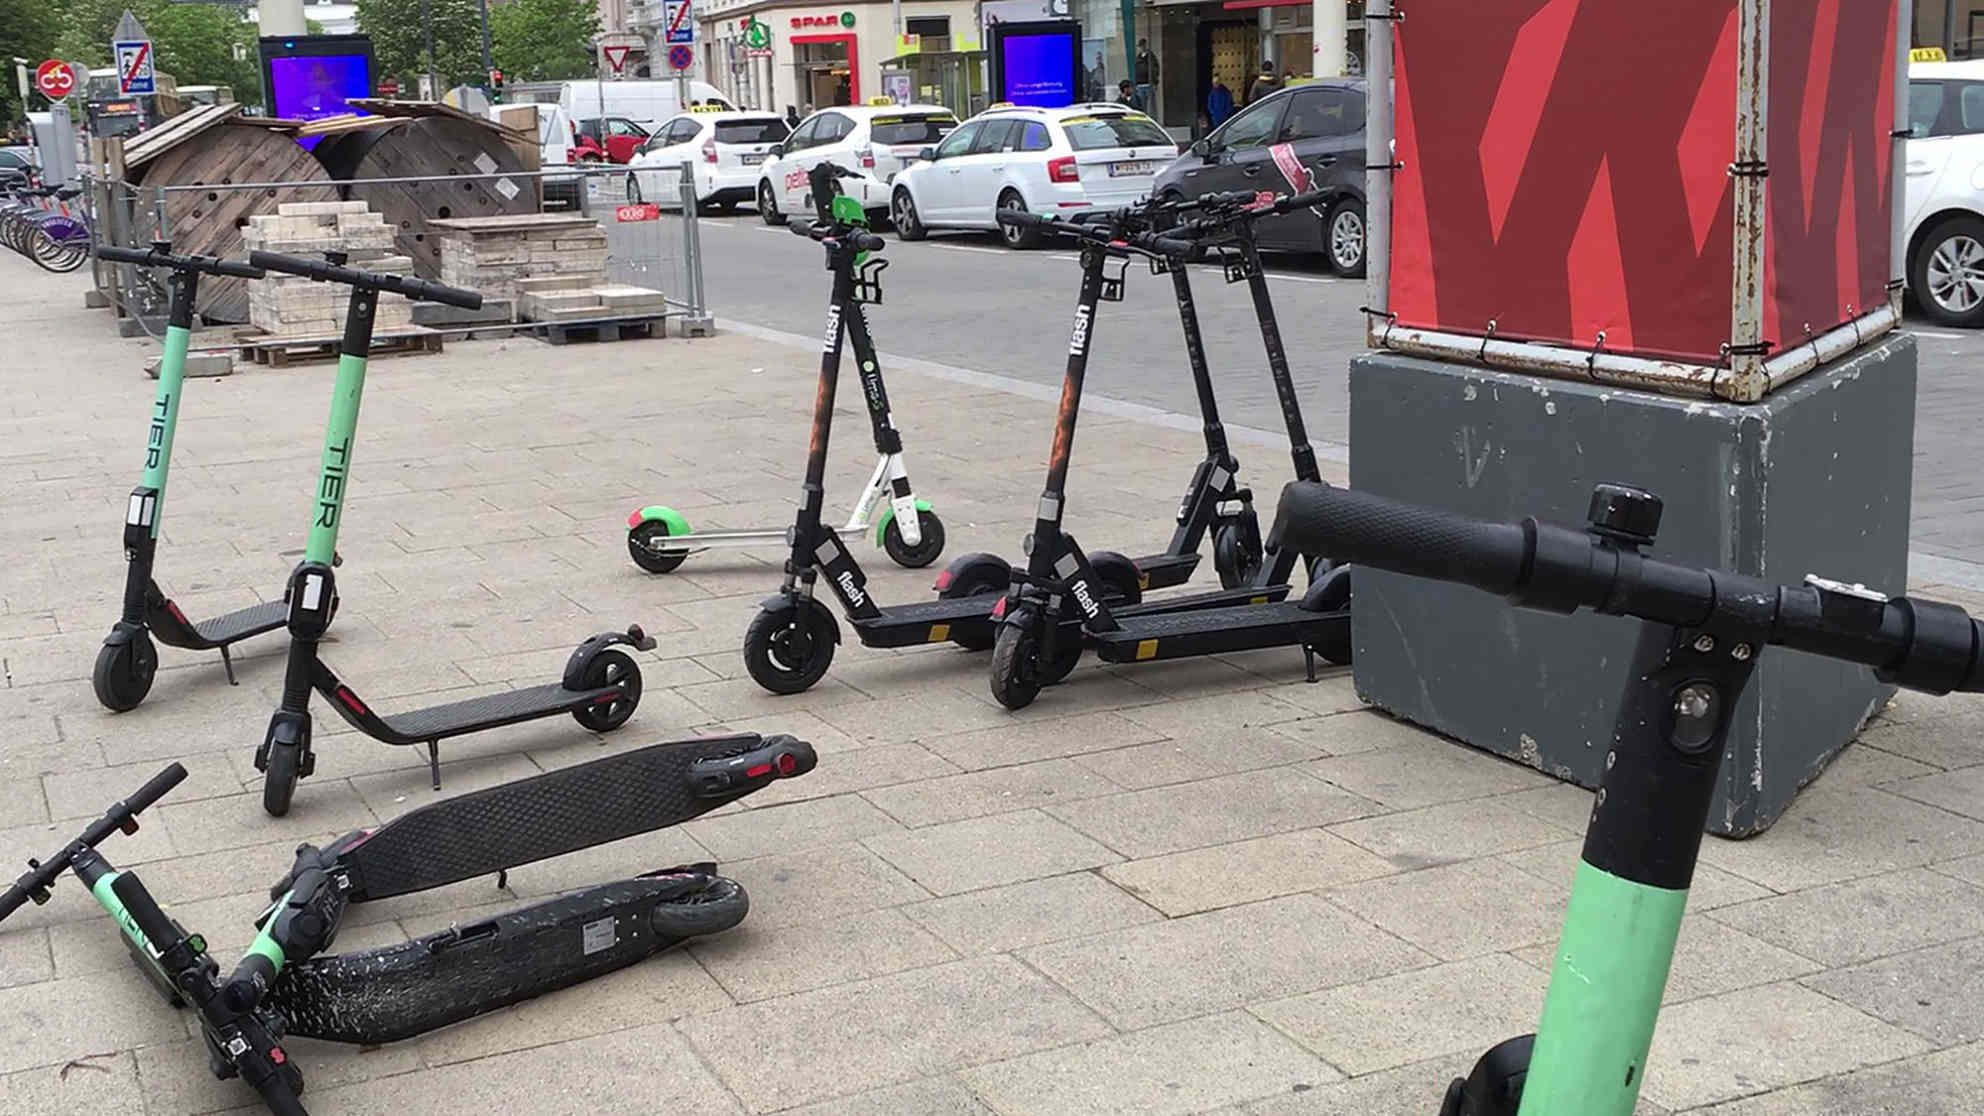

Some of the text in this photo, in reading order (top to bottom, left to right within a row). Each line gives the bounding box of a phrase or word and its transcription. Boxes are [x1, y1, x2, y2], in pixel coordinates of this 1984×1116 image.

[790, 15, 838, 29] SPAR
[823, 304, 842, 354] flash
[1069, 304, 1091, 356] flash
[144, 393, 170, 469] TIER
[316, 437, 349, 529] TIER
[837, 570, 864, 608] flash
[1071, 580, 1100, 619] flash
